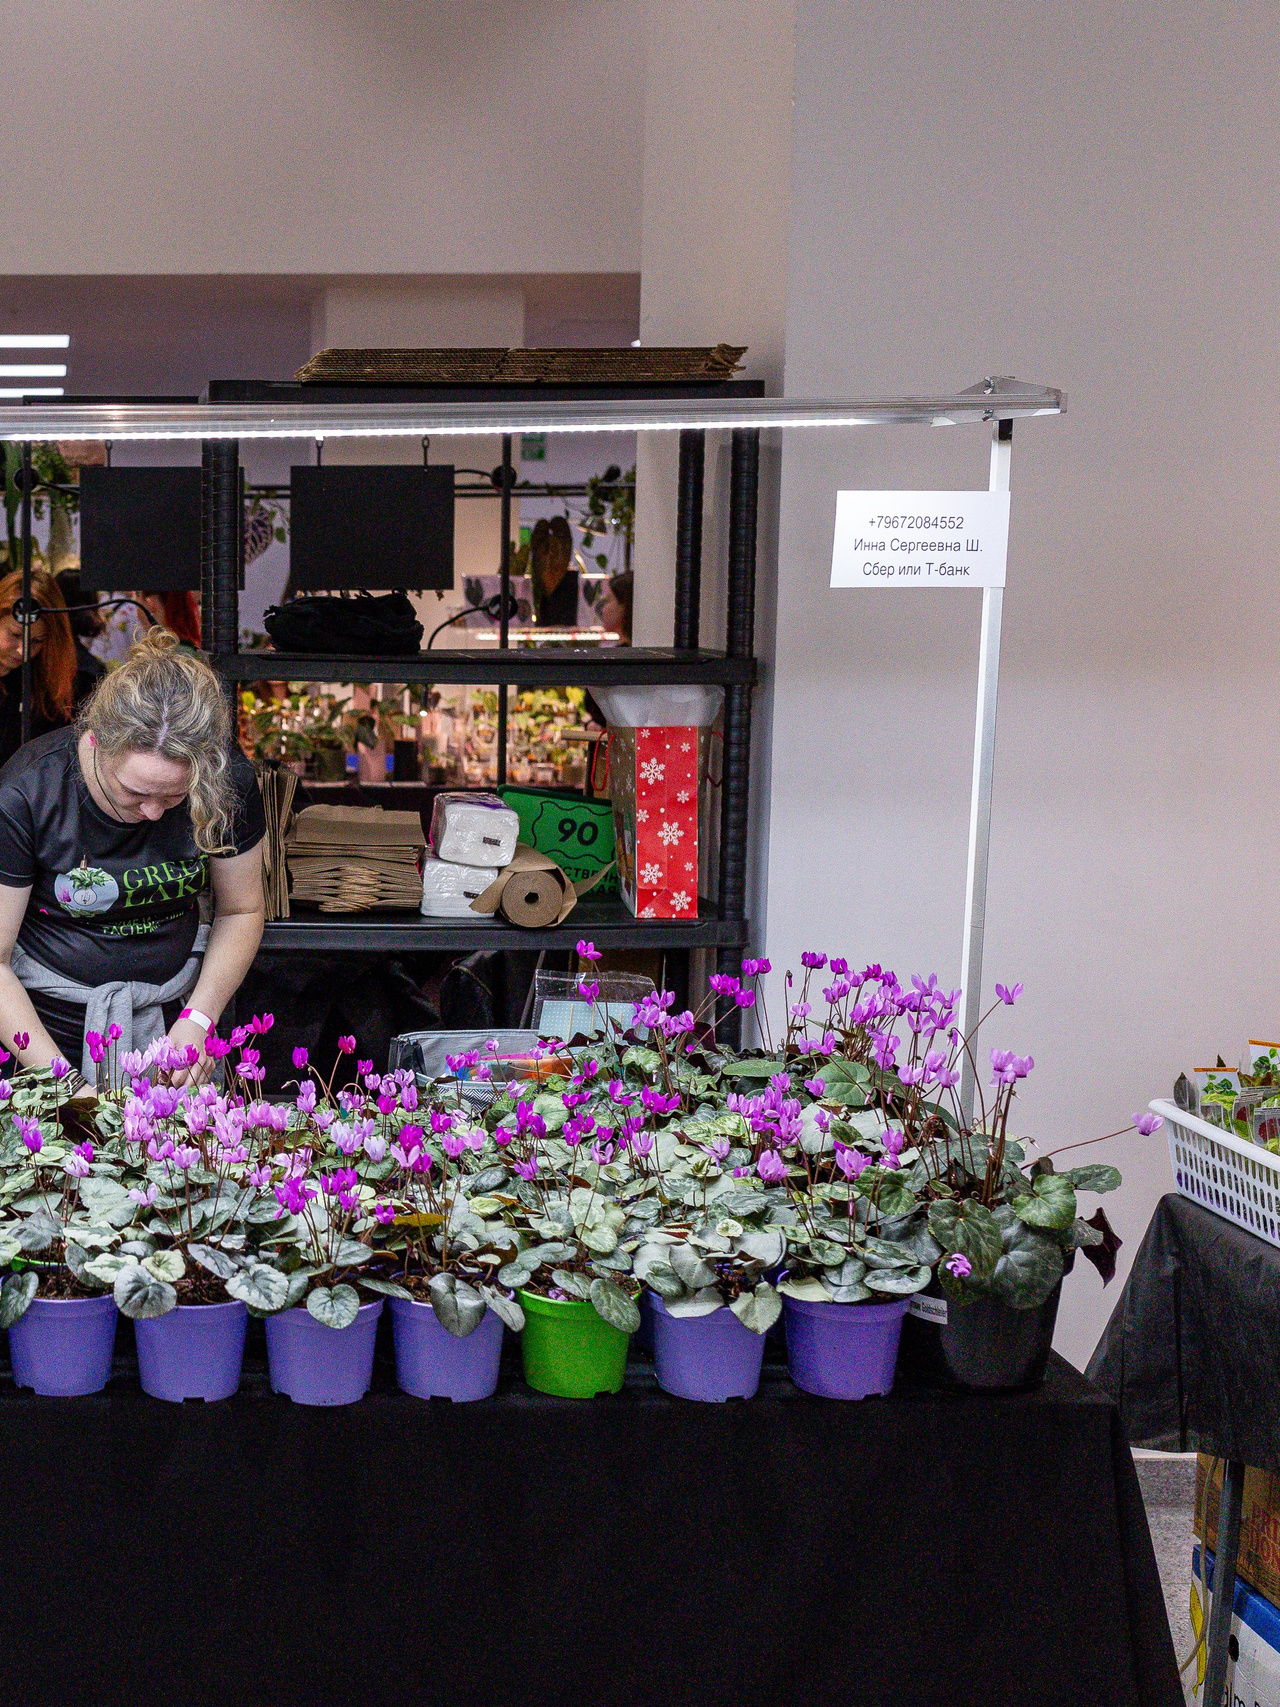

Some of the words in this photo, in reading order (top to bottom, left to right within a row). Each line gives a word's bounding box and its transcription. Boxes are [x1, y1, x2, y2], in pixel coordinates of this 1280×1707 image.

[869, 515, 964, 530] +79672084552
[854, 538, 886, 551] Инна
[890, 538, 961, 554] Сергеевна
[965, 539, 983, 552] Ш.
[862, 561, 894, 578] Сбер
[898, 565, 921, 576] или
[926, 562, 970, 576] Т-банк
[558, 817, 599, 846] 90
